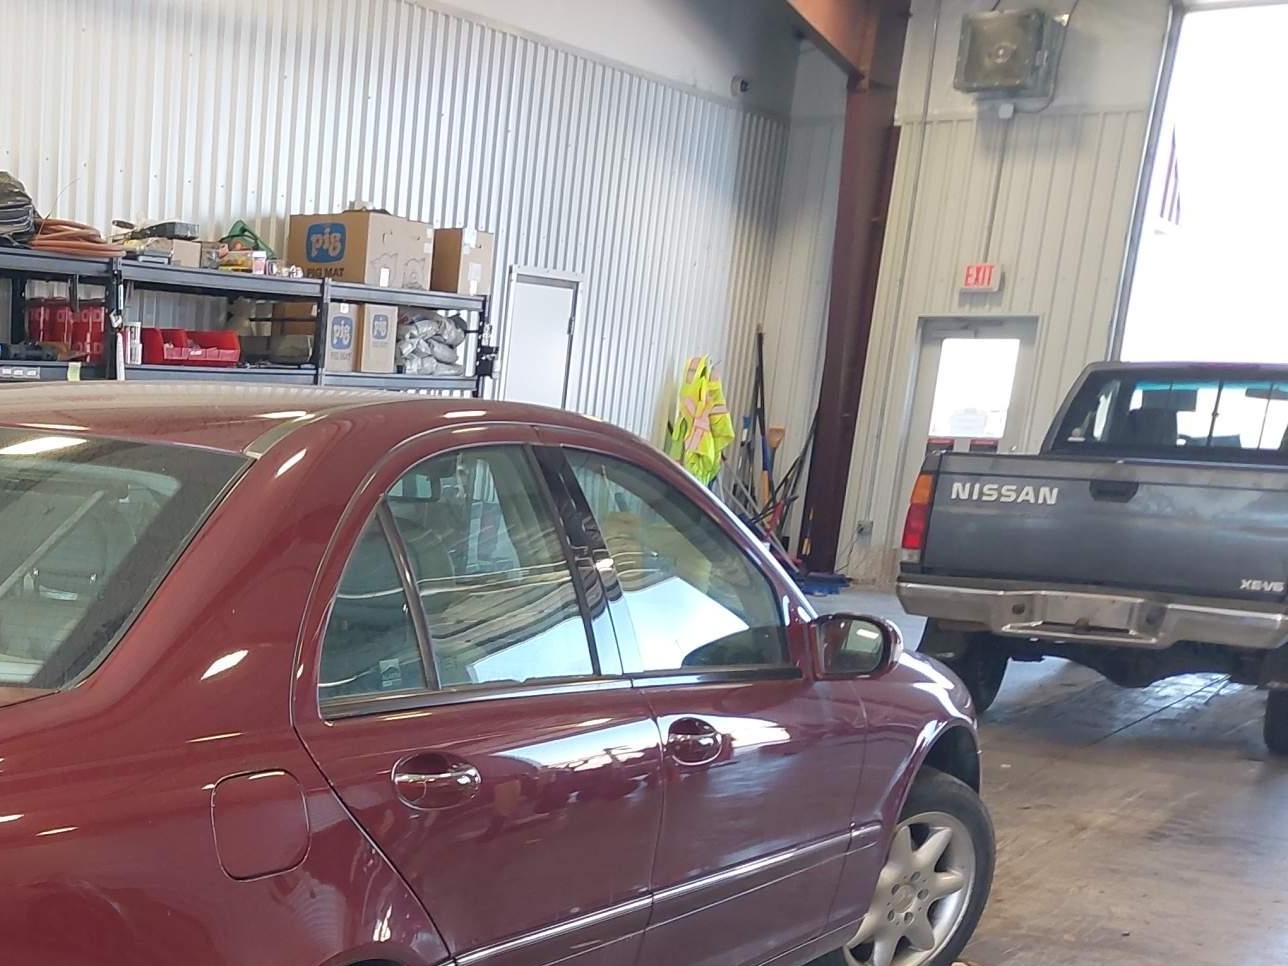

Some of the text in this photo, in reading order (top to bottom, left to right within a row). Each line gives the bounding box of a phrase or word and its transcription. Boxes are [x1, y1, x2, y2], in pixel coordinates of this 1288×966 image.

[311, 227, 342, 257] pig
[324, 268, 345, 277] MAT
[964, 265, 995, 287] EXIT
[951, 482, 1059, 505] NISSAN
